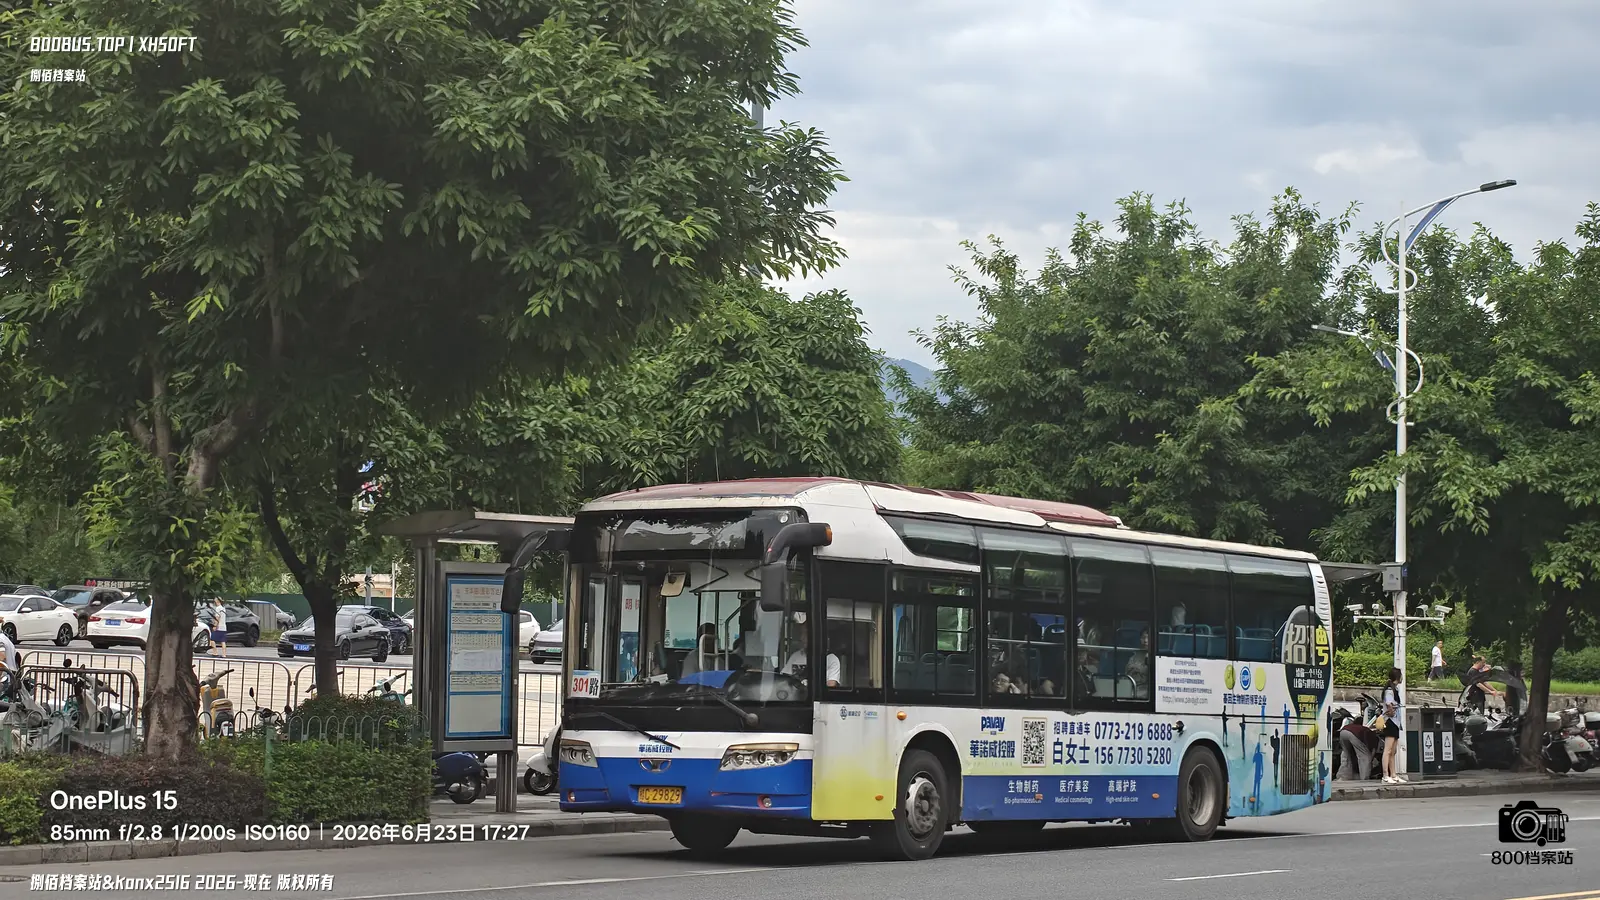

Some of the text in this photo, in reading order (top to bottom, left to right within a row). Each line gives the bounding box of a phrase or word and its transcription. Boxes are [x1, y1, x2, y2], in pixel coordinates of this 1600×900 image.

[573, 677, 599, 696] 301路
[981, 716, 1005, 731] pavay
[1053, 721, 1173, 741] 招聘直通车 0773-219 6888
[1052, 738, 1172, 765] 白女士 156 7730 5280
[1008, 780, 1137, 793] 生物制药 医疗美容 高端护肤
